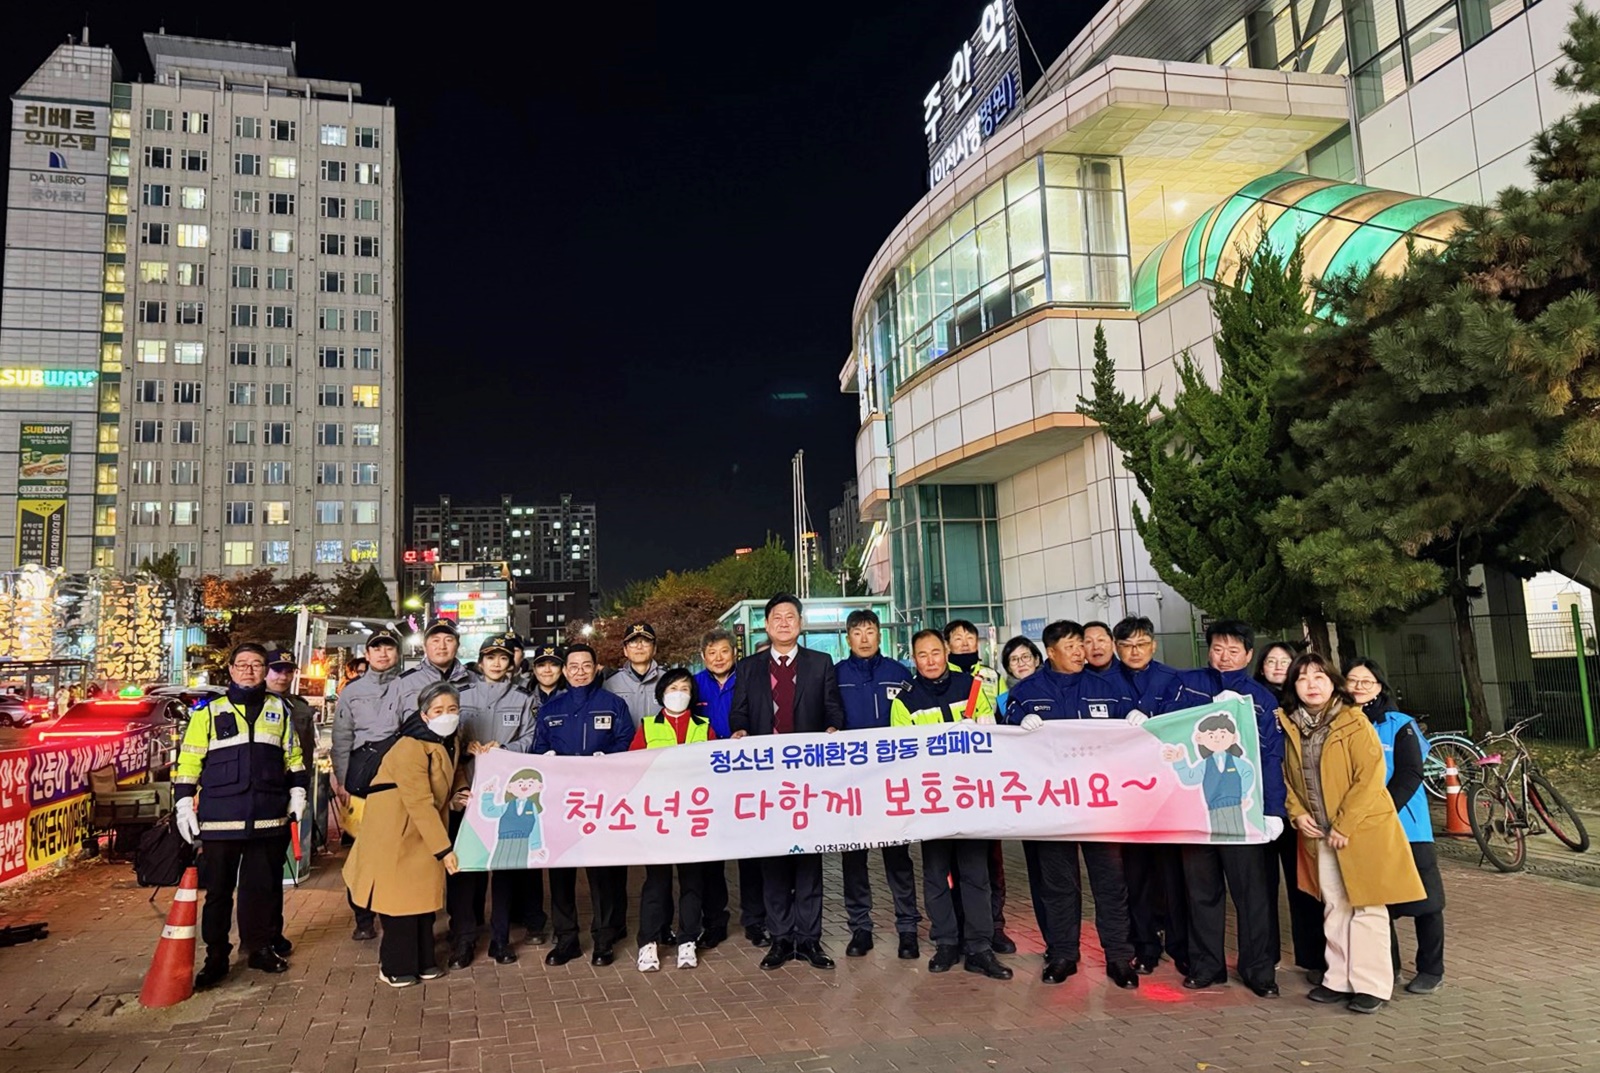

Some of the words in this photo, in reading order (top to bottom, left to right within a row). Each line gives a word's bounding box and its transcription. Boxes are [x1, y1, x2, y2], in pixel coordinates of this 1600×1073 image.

[924, 0, 1006, 143] 주안역
[24, 105, 96, 130] 리베로
[23, 131, 97, 151] 오피스텔
[29, 172, 46, 183] DA
[49, 174, 87, 186] LIBERO
[0, 369, 98, 387] SUBWAY
[22, 426, 70, 434] SUBWAY
[710, 748, 775, 773] 청소년
[781, 740, 868, 769] 유해환경
[875, 738, 919, 763] 합동
[926, 730, 993, 756] 캠페인
[30, 750, 70, 800] 신동아
[566, 786, 714, 837] 청소년을
[734, 781, 862, 831] 다함께
